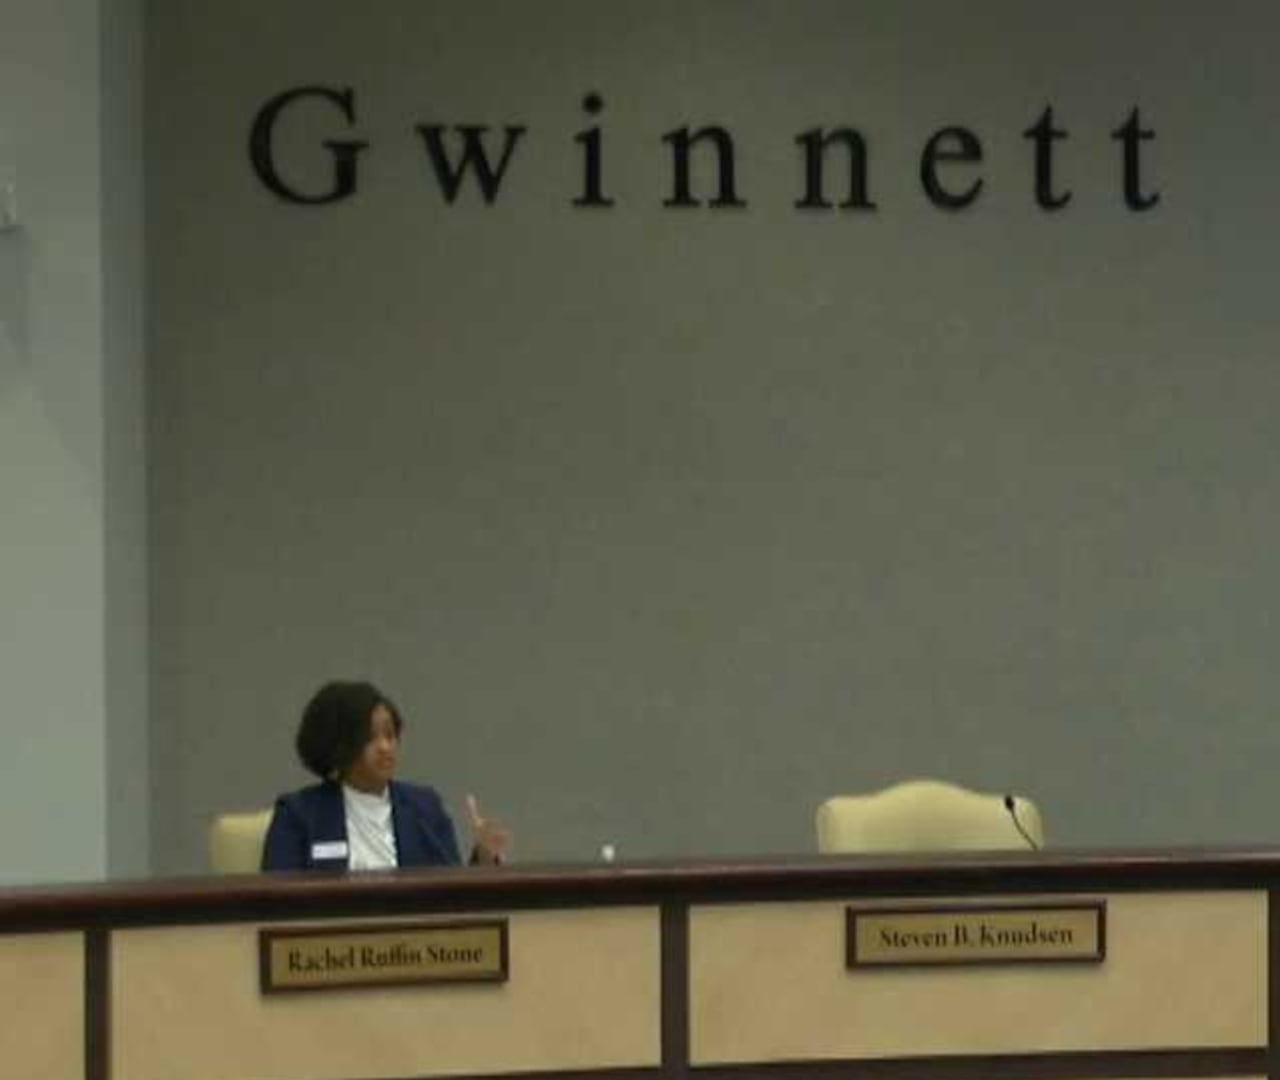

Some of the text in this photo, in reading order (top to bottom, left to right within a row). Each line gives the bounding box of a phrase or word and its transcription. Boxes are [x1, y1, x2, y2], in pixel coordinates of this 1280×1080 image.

[247, 84, 1161, 212] Gwinnett
[879, 924, 947, 948] Steven
[980, 920, 1074, 946] Knudsen
[288, 942, 484, 973] Rachel Ruffin Stone
